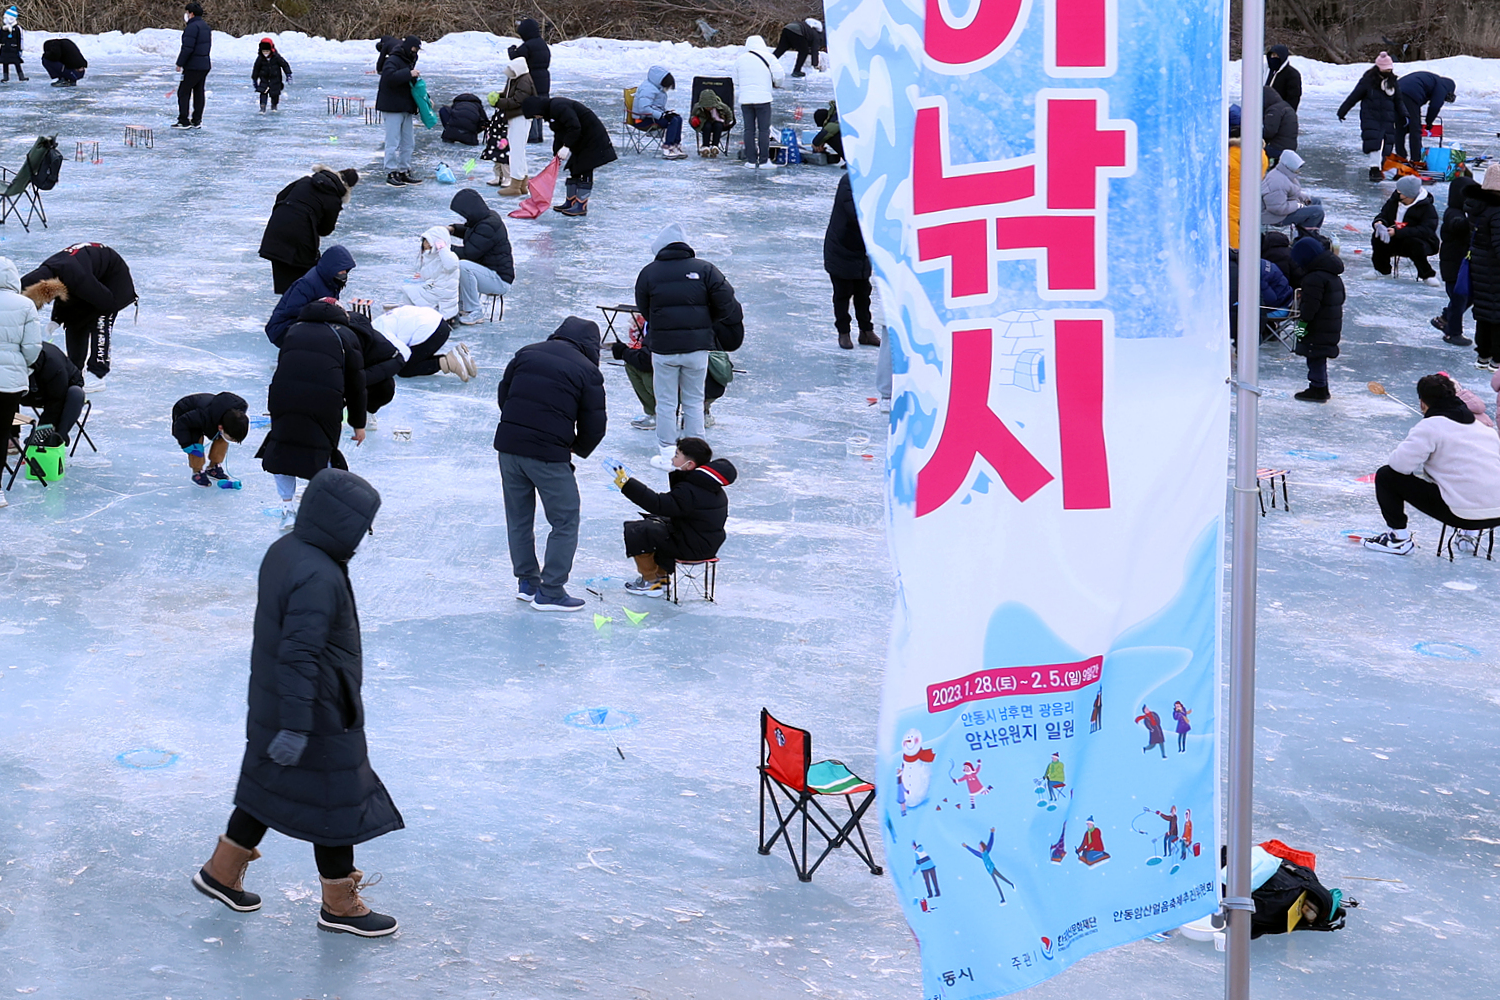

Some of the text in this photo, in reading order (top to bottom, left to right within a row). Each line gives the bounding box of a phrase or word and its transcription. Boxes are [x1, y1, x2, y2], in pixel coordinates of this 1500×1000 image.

[961, 701, 1074, 727] 안동시 남후면 광음리
[965, 719, 1074, 751] 암산유원지 일원
